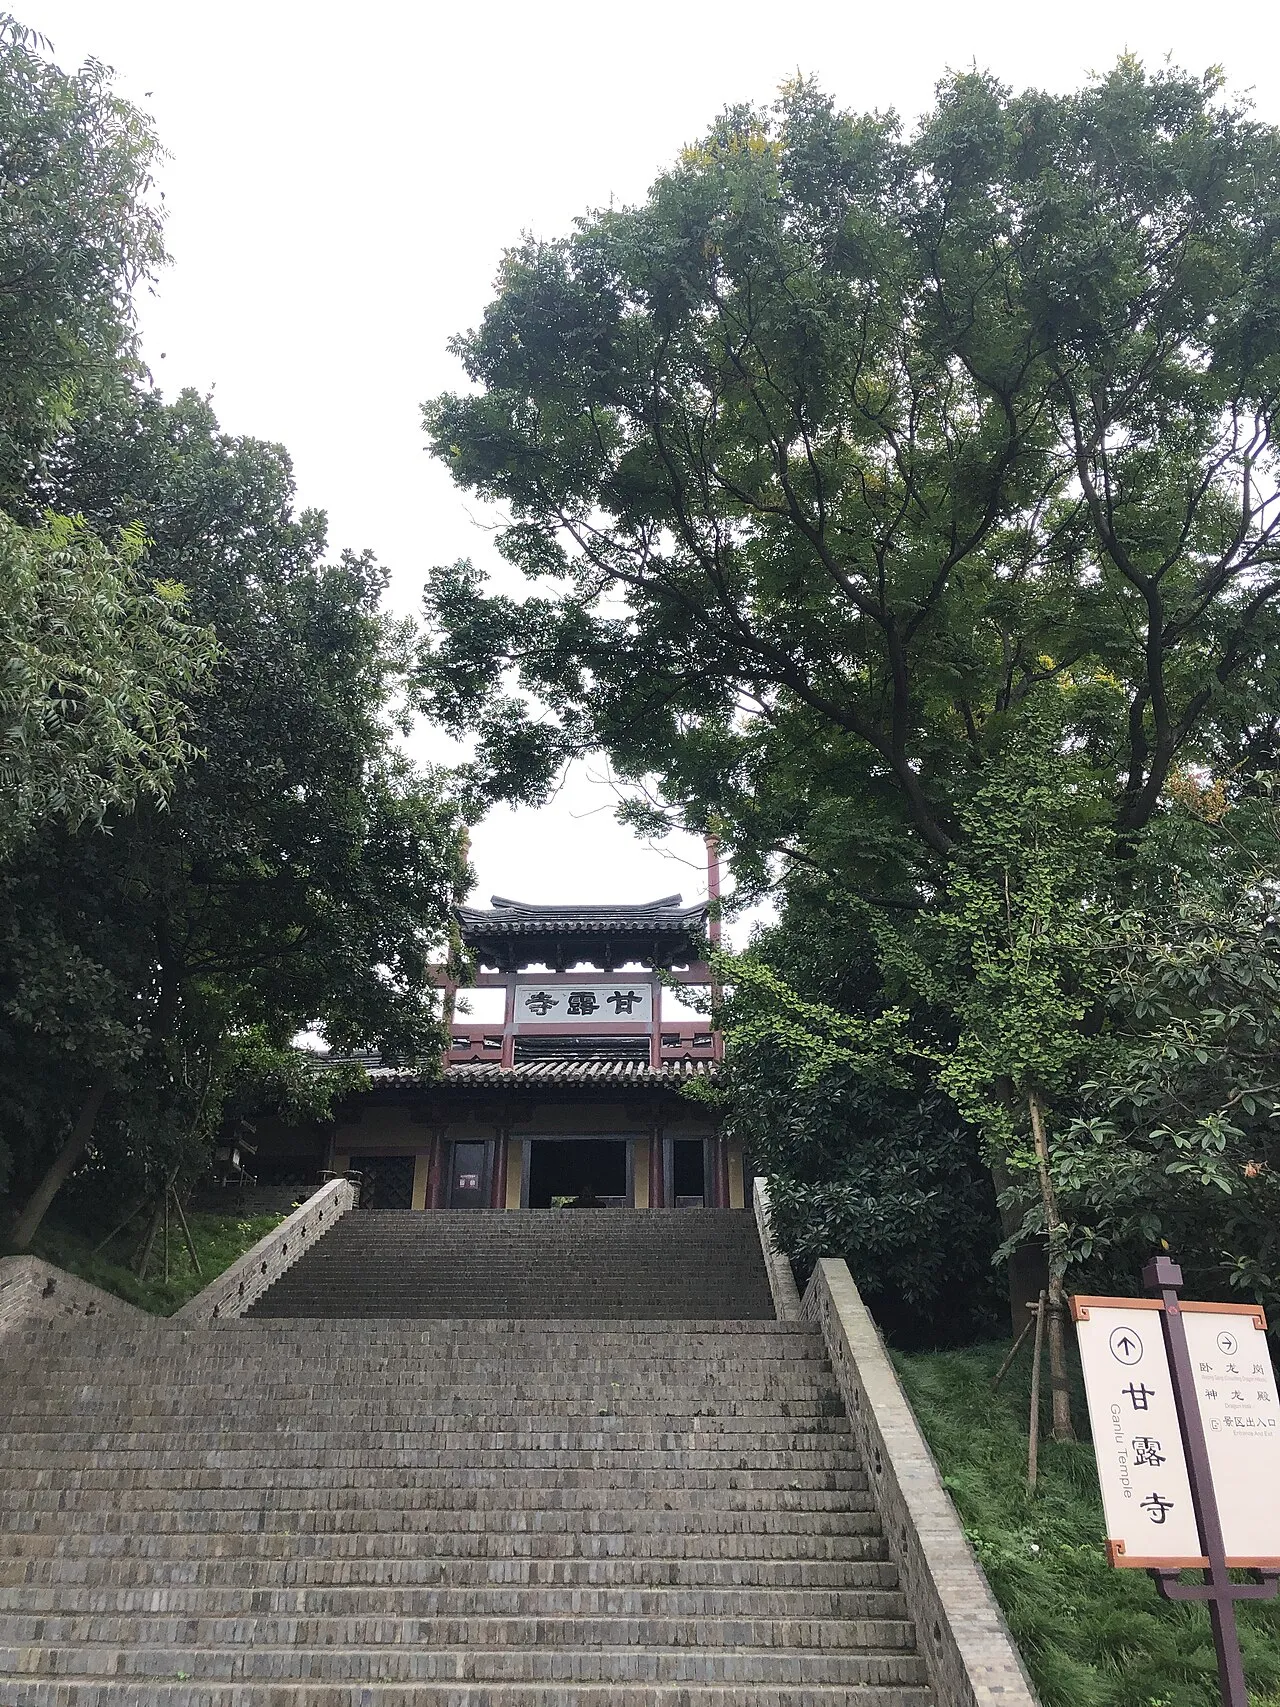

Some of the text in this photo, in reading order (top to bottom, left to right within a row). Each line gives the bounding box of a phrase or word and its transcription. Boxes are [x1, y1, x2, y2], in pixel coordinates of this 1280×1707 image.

[1110, 1403, 1133, 1498] Ganlu Temple
[1121, 1382, 1174, 1524] 甘露寺
[1223, 1416, 1276, 1427] 景区出入口
